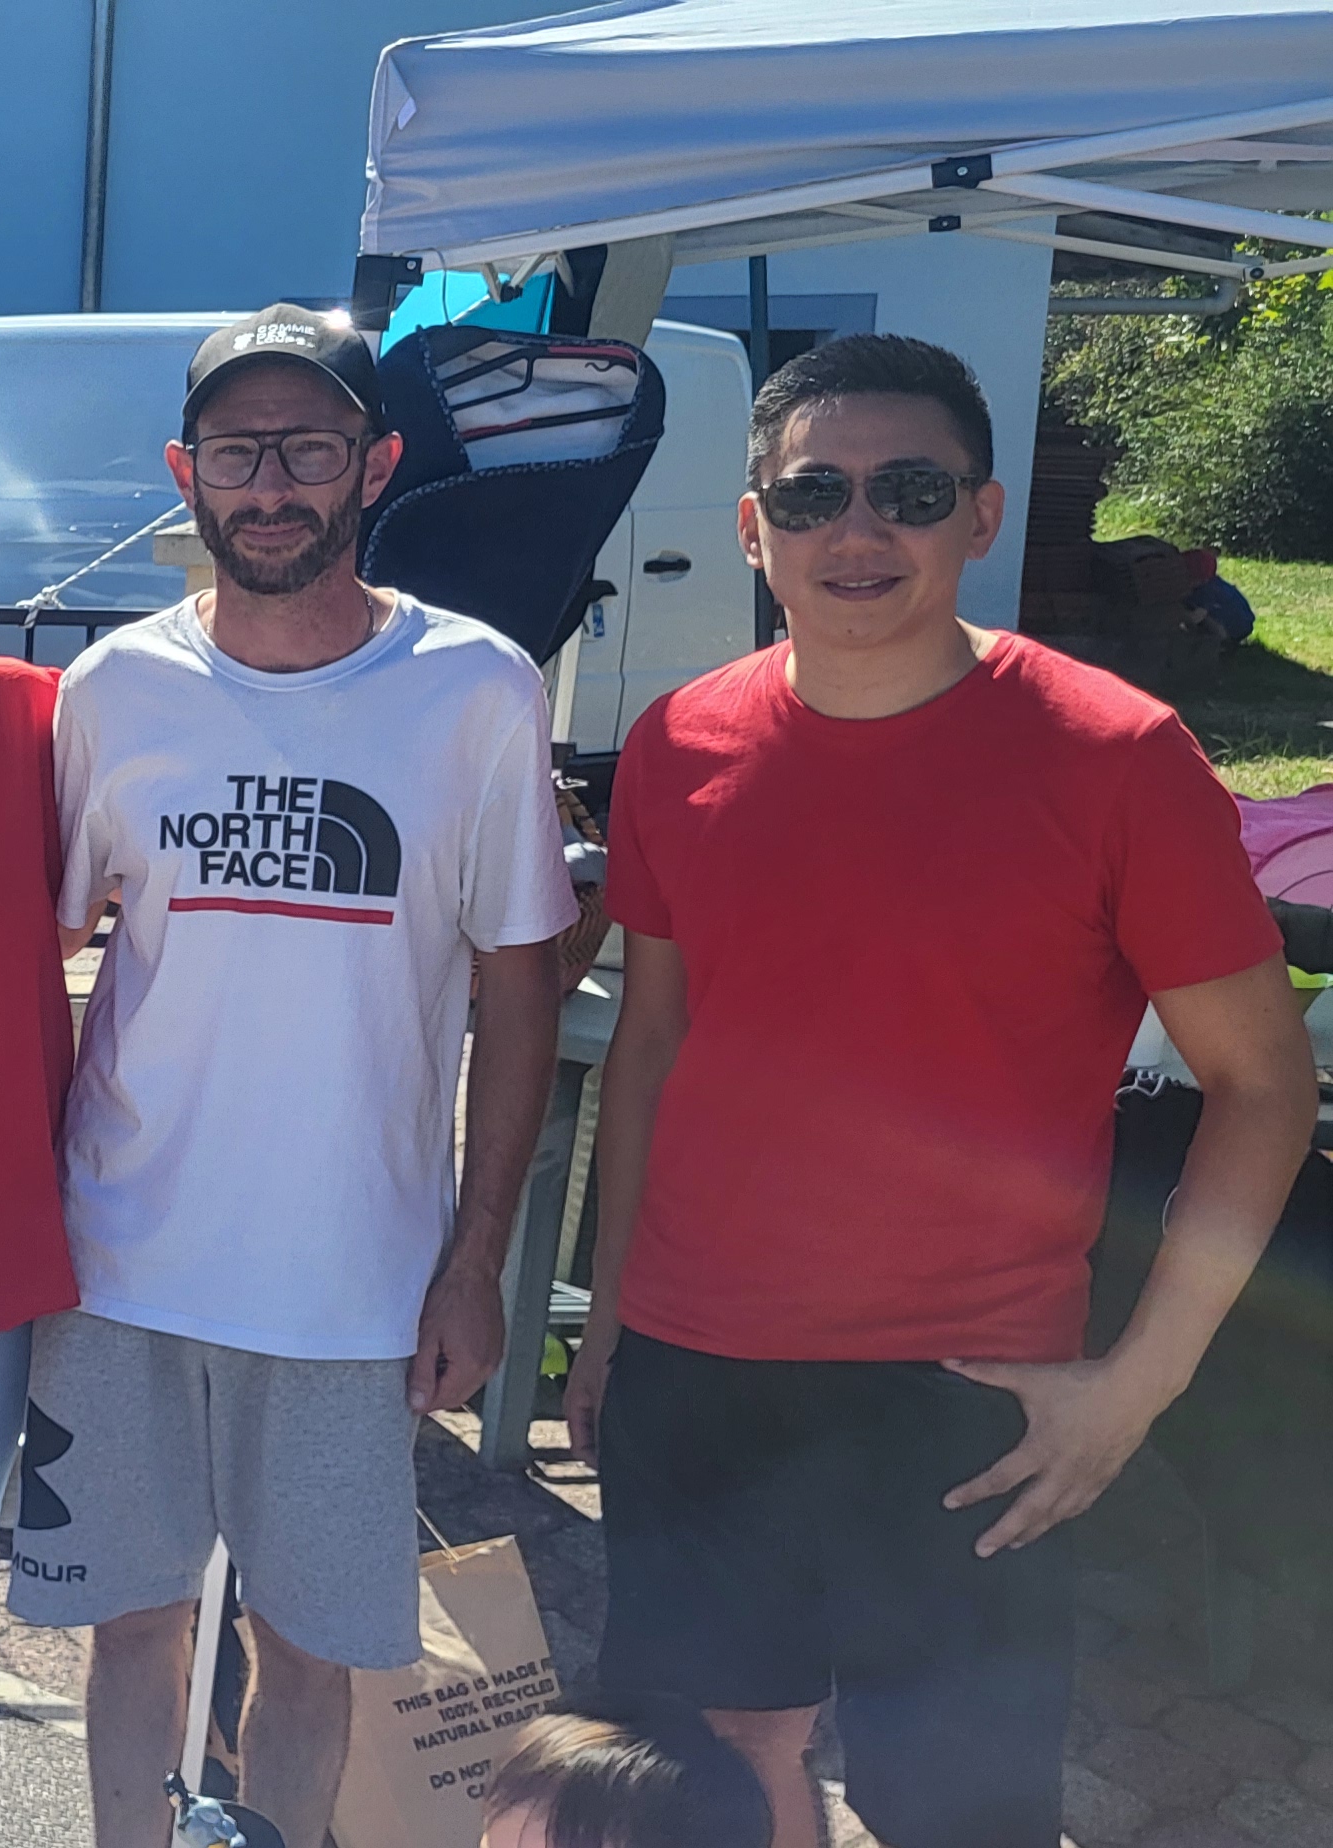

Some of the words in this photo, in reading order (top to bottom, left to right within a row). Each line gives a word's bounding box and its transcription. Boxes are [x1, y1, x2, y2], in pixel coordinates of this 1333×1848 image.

[226, 775, 318, 814] THE
[159, 812, 314, 852] NORTH
[199, 850, 310, 890] FACE
[393, 1692, 432, 1714] THIS
[434, 1682, 469, 1702] BAG
[473, 1676, 489, 1692] IS
[491, 1661, 539, 1687] MADE
[438, 1700, 479, 1722] 100%
[481, 1678, 555, 1711] RECYCLED
[413, 1719, 491, 1751] NATURAL
[492, 1703, 541, 1728] KRAFT
[430, 1771, 456, 1789] DO
[458, 1758, 492, 1781] NOT
